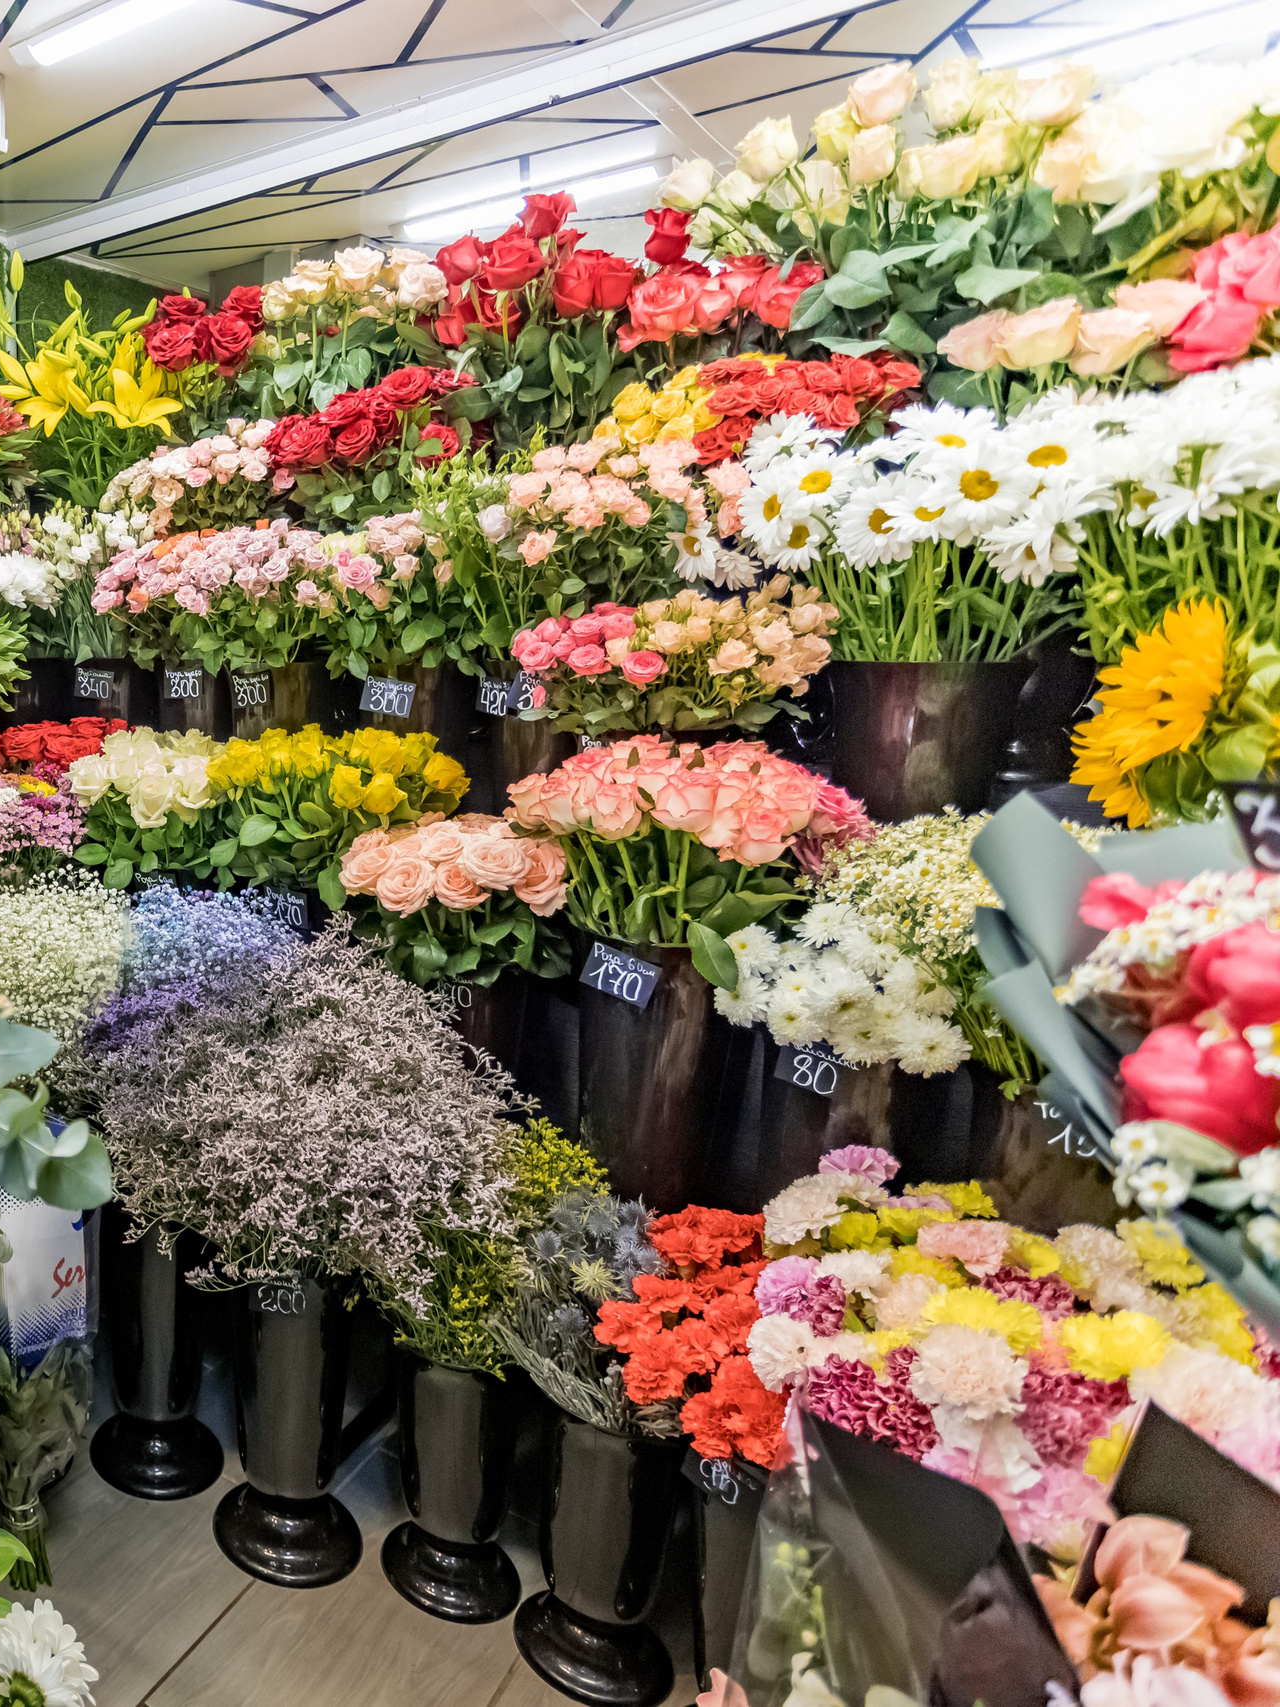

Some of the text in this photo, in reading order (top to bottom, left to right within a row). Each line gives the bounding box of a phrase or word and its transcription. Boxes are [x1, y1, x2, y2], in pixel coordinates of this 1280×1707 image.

[78, 676, 109, 698] 340
[170, 679, 199, 698] 300
[235, 684, 267, 706] 300
[370, 688, 409, 716] 300
[480, 688, 508, 717] 420
[266, 886, 286, 901] Роза
[277, 899, 303, 926] 170
[593, 942, 623, 966] Роза
[589, 962, 641, 1001] 170
[792, 1054, 837, 1095] 80
[257, 1285, 305, 1314] 200
